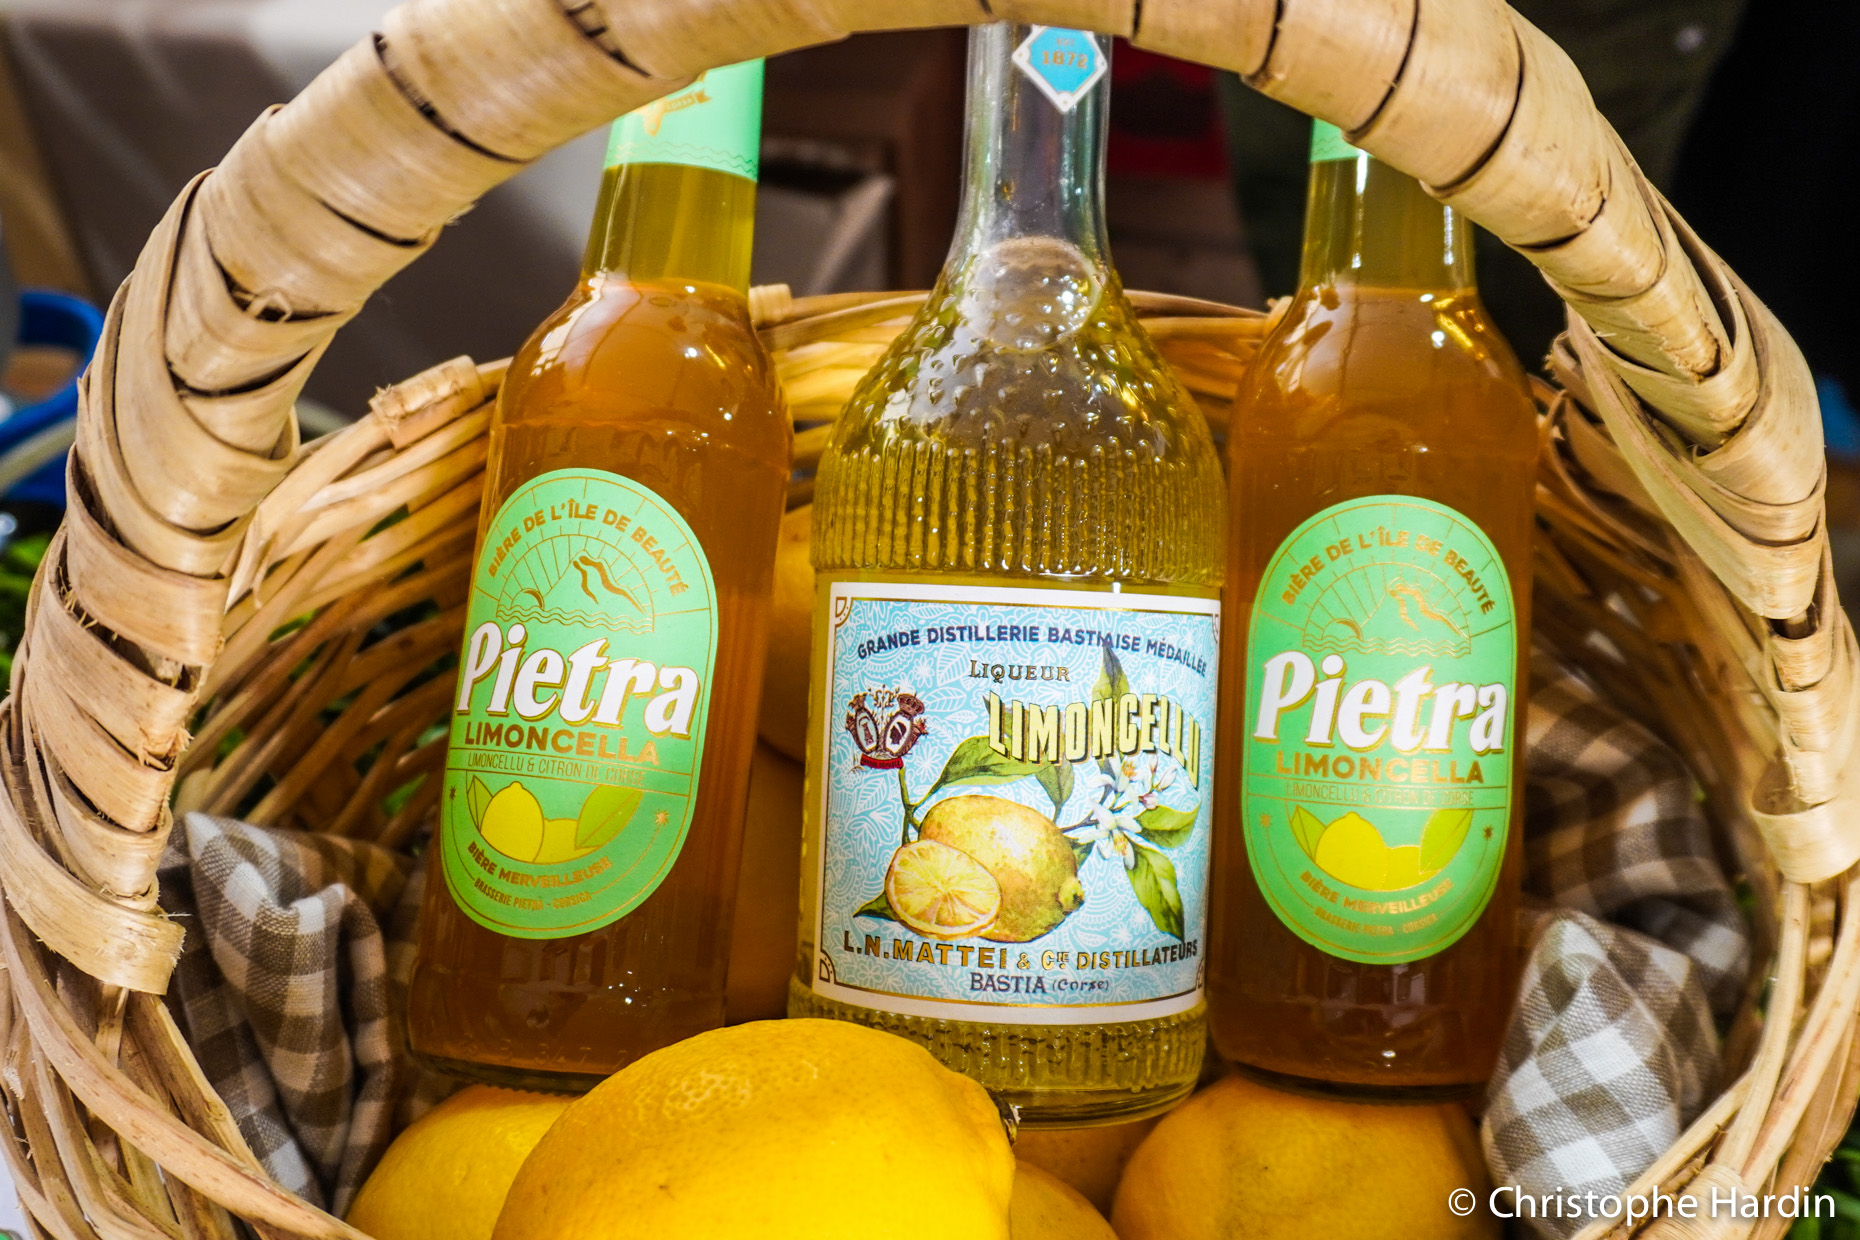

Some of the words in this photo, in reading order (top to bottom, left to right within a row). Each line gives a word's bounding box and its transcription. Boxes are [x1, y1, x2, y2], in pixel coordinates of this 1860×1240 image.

[1042, 50, 1088, 69] 1872
[488, 527, 522, 578] BIÈRE
[523, 509, 546, 534] DE
[550, 498, 599, 521] L'ÎLE
[602, 509, 632, 533] DE
[630, 526, 690, 597] BEAUTÉ
[1281, 555, 1325, 606] BIÈRE
[1325, 537, 1354, 562] DE
[1357, 525, 1410, 550] L'ÎLE
[1415, 534, 1444, 558] DE
[1444, 548, 1496, 616] BEAUTÉ
[857, 626, 921, 659] GRANDE
[927, 624, 1040, 644] DISTILLERIE
[1048, 627, 1141, 652] BASTIAISE
[1146, 637, 1207, 678] MÉDAILLÉE
[969, 659, 1071, 684] LIQUEUR
[456, 621, 701, 740] Pietra
[1253, 650, 1509, 756] Pietra
[464, 721, 660, 766] LIMONCELLA
[988, 689, 1201, 792] LIMONCELLU
[468, 753, 524, 771] LIMONCELLU
[527, 758, 534, 772] &
[538, 760, 582, 778] CITRON
[585, 764, 601, 781] DE
[605, 766, 646, 786] CORSE
[1276, 750, 1485, 784] LIMONCELLA
[1286, 781, 1359, 802] LIMONCELLU
[1374, 788, 1419, 805] CITRON
[1422, 790, 1436, 806] DE
[1441, 791, 1474, 806] CORSE
[467, 841, 496, 875] BIÈRE
[498, 855, 613, 888] MERVEILLEUSE
[474, 877, 512, 906] BRASSERIE
[1300, 870, 1340, 904] BIÈRE
[1342, 878, 1454, 915] MERVEILLEUSE
[1017, 954, 1031, 970] &
[1076, 941, 1198, 970] DISTILLATEURS
[969, 972, 1047, 994] BASTIA
[1052, 978, 1109, 992] (Corse)
